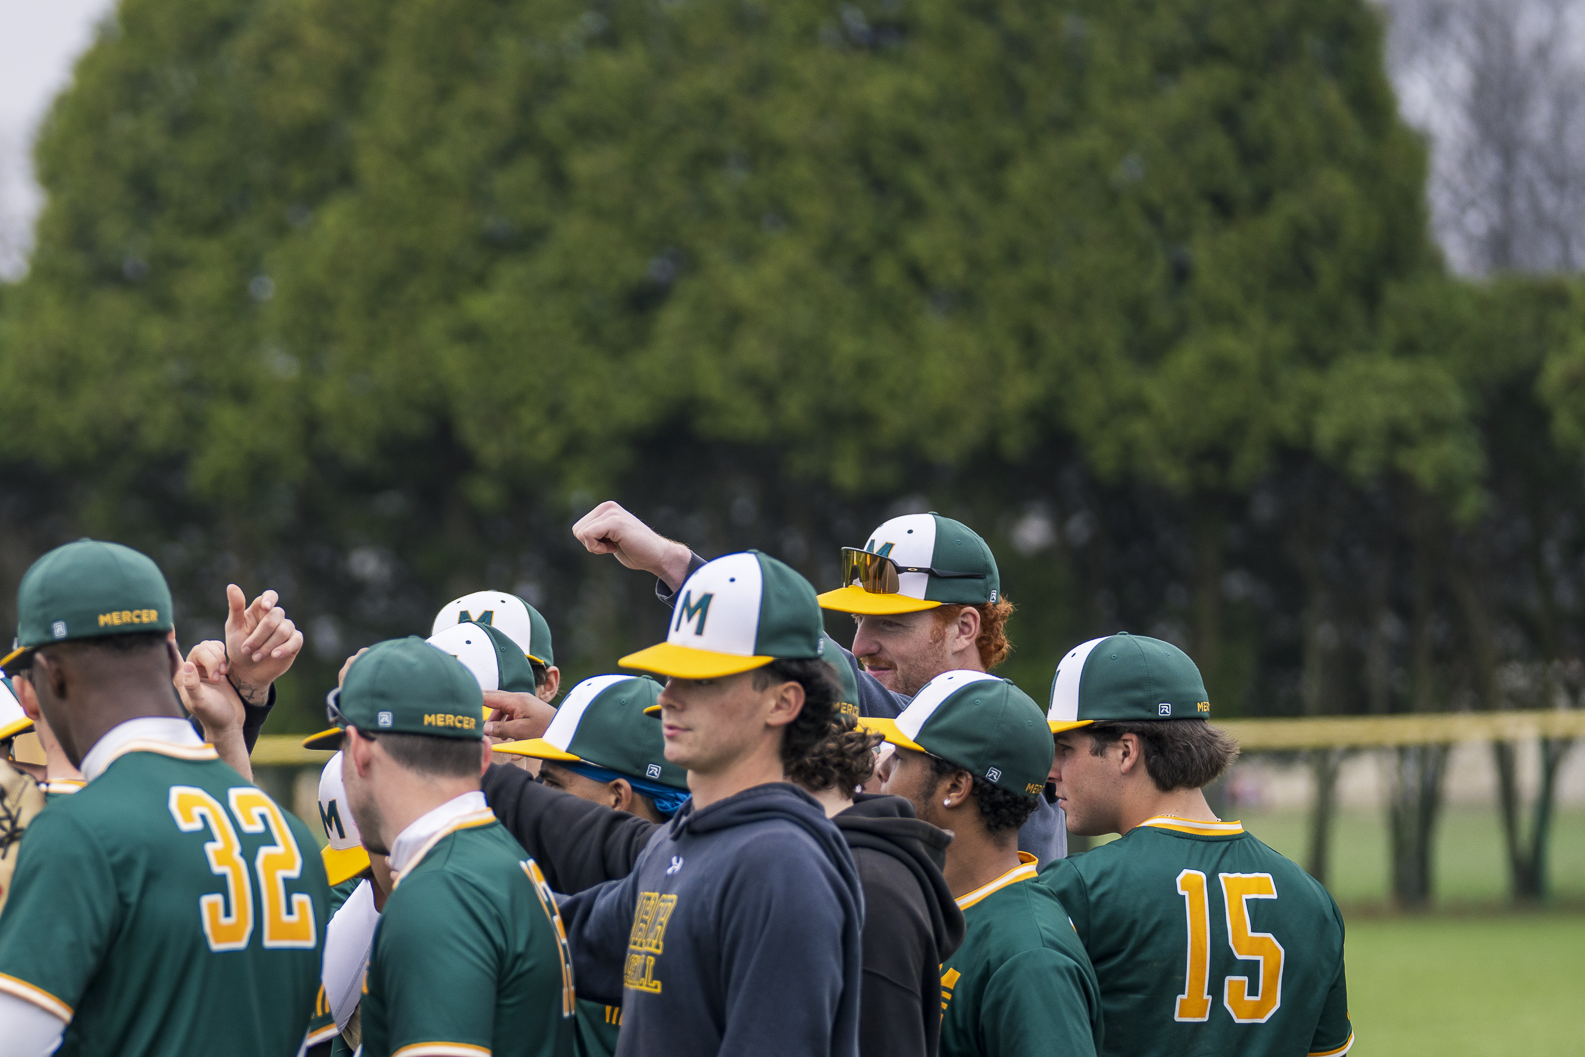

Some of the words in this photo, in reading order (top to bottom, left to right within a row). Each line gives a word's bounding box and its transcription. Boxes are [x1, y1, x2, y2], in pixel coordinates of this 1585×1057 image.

[98, 609, 158, 628] MERCER
[675, 589, 715, 636] M
[423, 713, 477, 730] MERCER
[318, 798, 347, 840] M
[169, 784, 318, 952] 32
[1174, 868, 1286, 1023] 15
